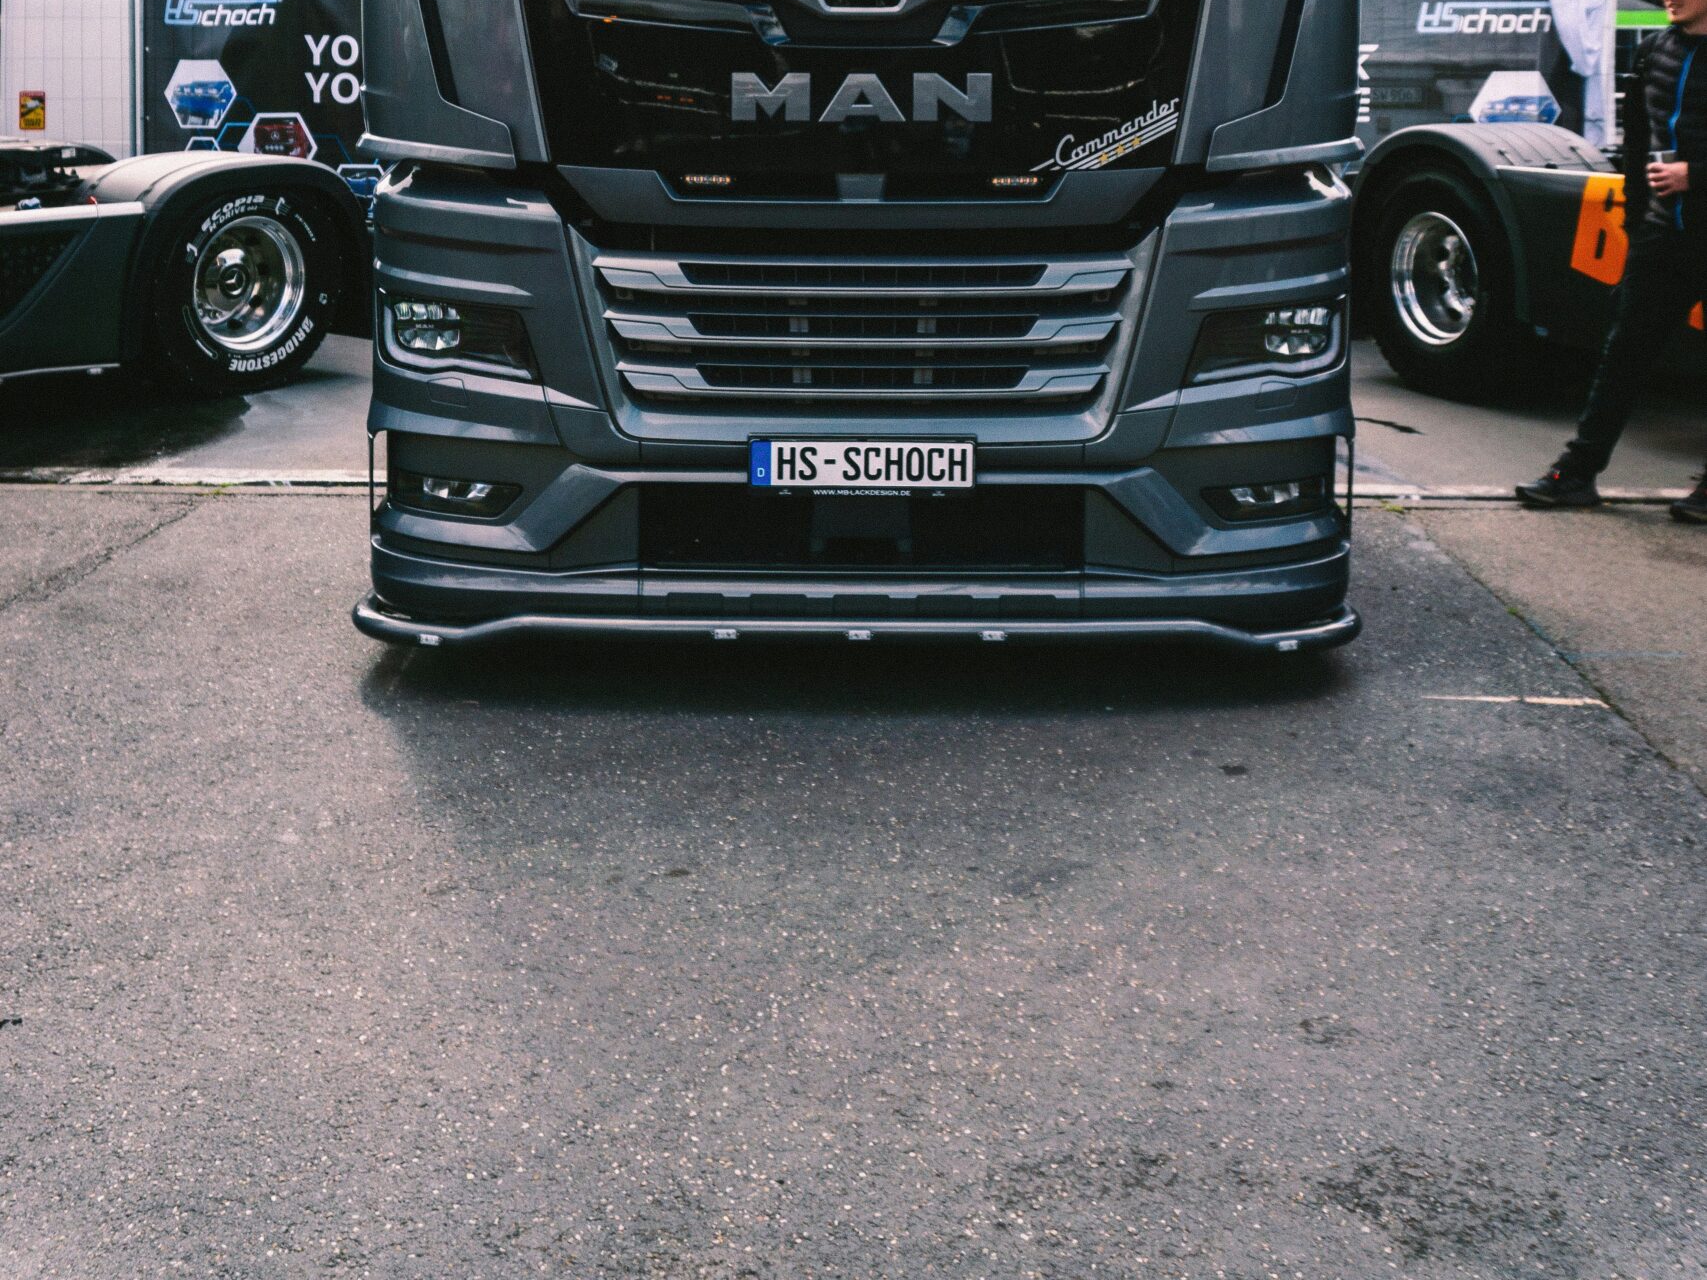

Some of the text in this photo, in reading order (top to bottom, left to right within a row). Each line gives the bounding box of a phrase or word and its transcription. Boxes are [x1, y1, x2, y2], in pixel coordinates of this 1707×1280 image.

[731, 72, 993, 122] MAN
[1055, 97, 1180, 167] Commander
[229, 315, 314, 372] BRIDGESTONE
[757, 467, 765, 477] D
